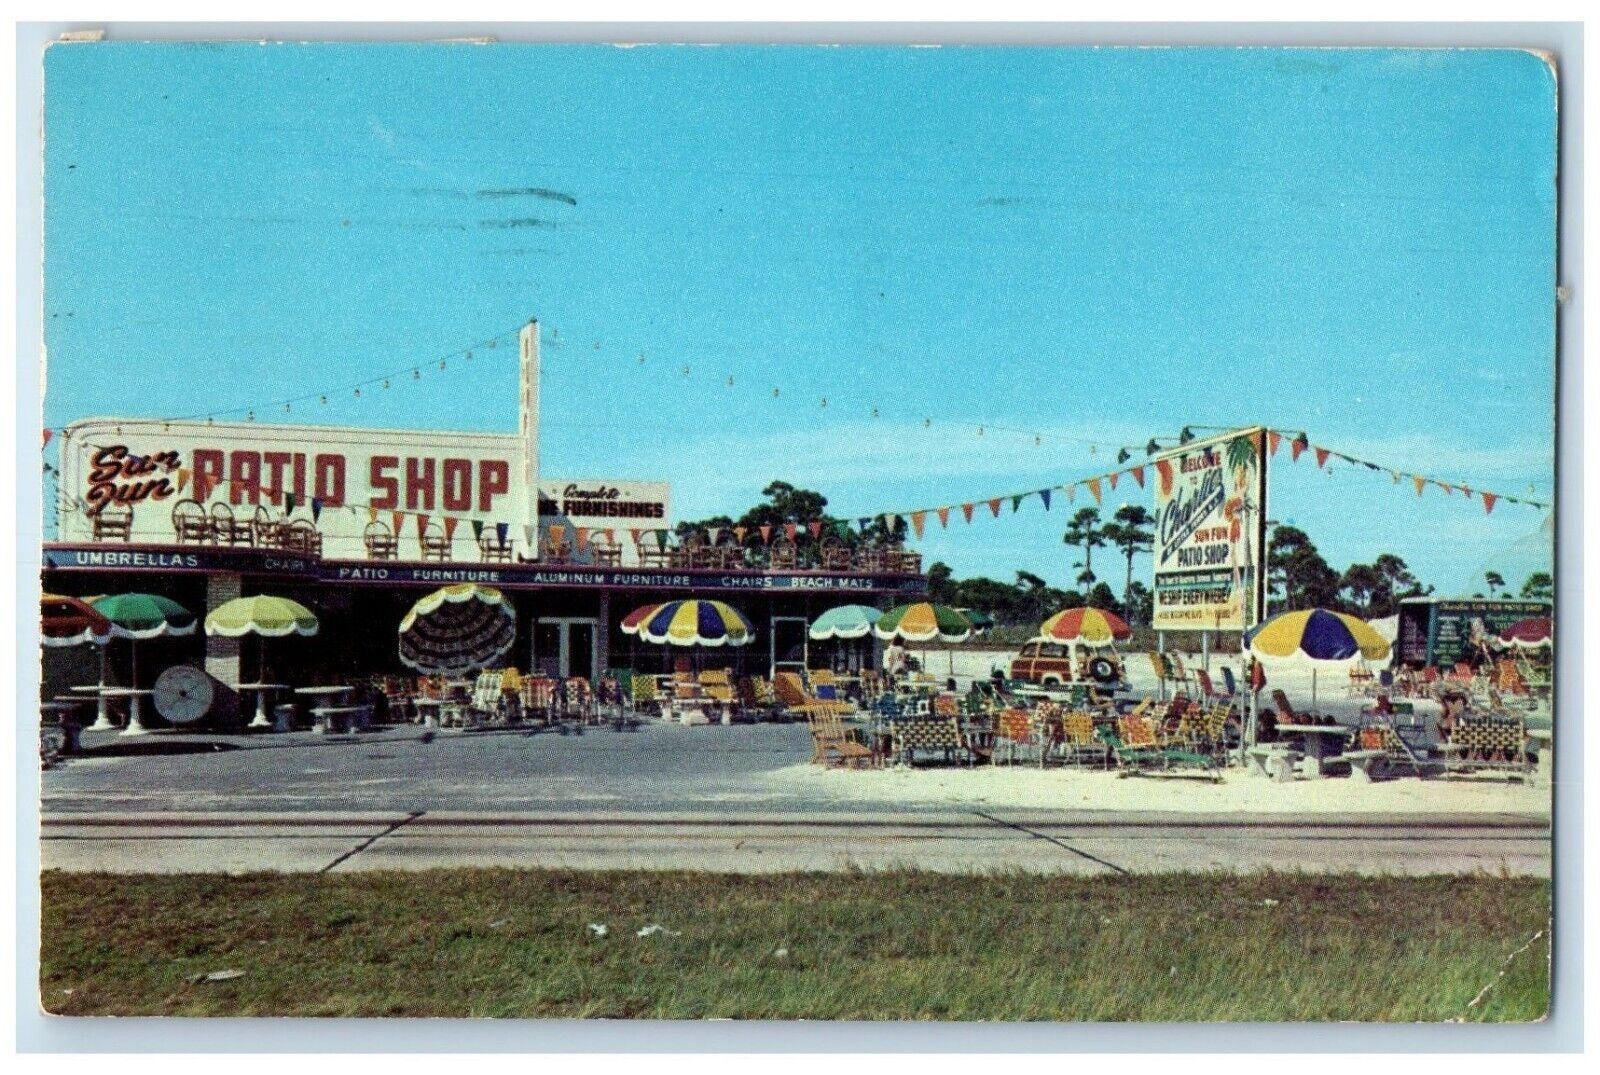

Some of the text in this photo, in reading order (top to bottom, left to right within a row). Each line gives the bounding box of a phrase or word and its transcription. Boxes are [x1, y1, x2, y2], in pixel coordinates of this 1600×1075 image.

[88, 444, 181, 484] Sun
[1180, 451, 1221, 474] WELCOME
[192, 449, 509, 511] PATIO SHOP
[563, 483, 620, 499] Complete
[86, 478, 175, 517] Fun
[563, 501, 664, 518] FURNISHINGS
[1194, 526, 1228, 543] SUN FUN
[76, 551, 198, 567] UMBRELLAS
[1178, 543, 1229, 567] PATIO SHOP
[339, 568, 873, 589] PATIO FURNITURE ALUMINUM FURNITURE CHAIRS BEACH MATS
